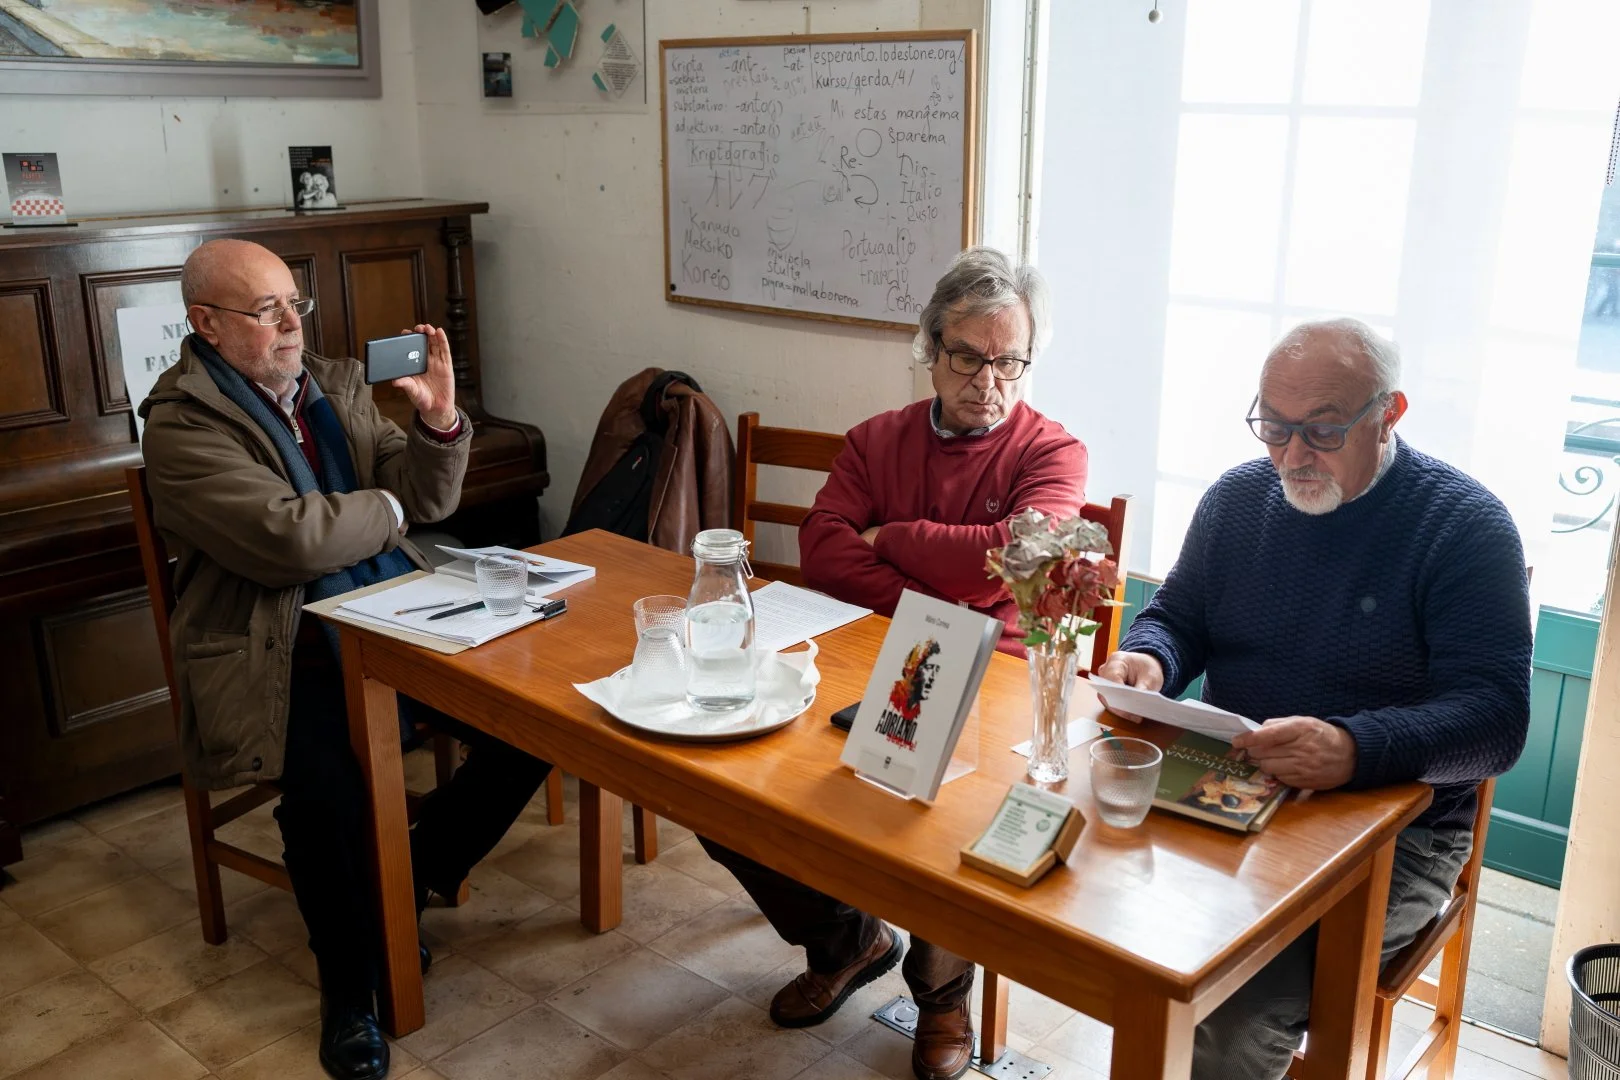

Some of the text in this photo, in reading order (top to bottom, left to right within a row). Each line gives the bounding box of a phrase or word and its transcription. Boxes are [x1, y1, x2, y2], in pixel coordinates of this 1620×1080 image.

[830, 98, 844, 120] Mi
[854, 99, 887, 120] estas
[900, 180, 942, 204] Italio
